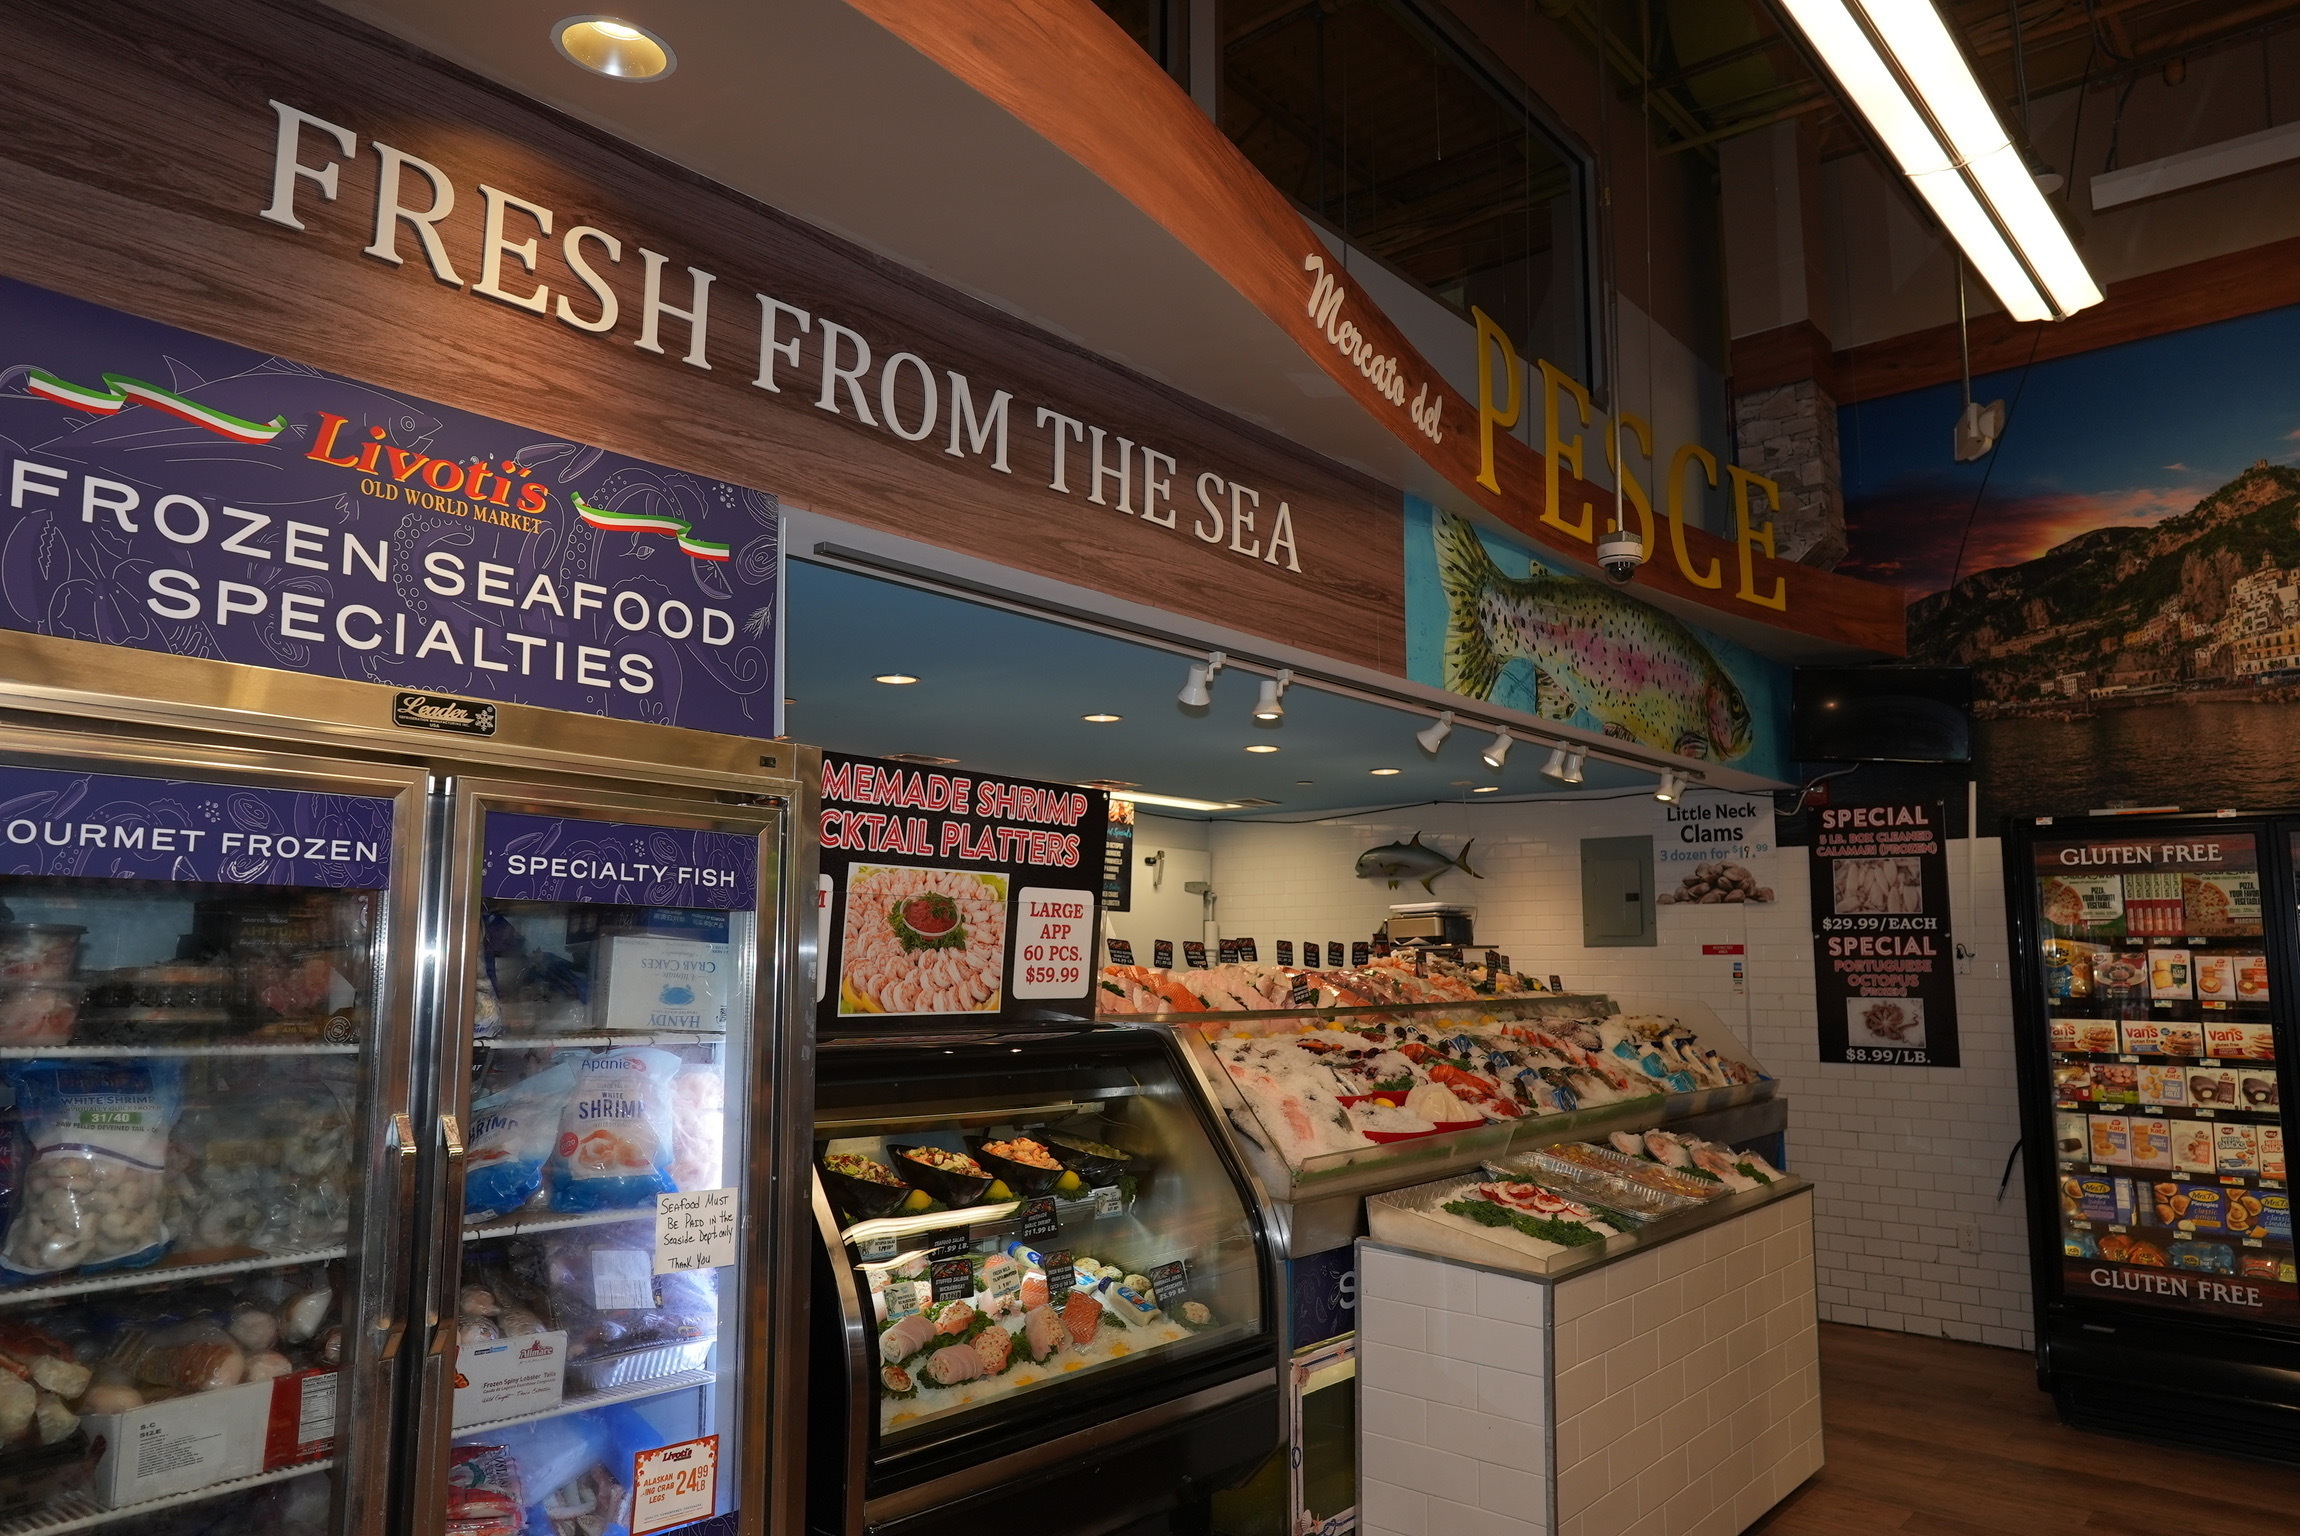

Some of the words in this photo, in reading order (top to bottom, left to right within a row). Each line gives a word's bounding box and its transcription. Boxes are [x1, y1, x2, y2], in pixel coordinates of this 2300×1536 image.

[259, 98, 717, 371] FRESH
[751, 292, 1014, 474] FROM
[1036, 406, 1177, 530] THE
[1194, 471, 1302, 574] SEA
[1304, 252, 1406, 407] Mercato
[1411, 382, 1443, 445] del
[304, 410, 550, 515] Livoti's
[1471, 304, 1787, 612] PESCE
[360, 478, 401, 503] OLD
[404, 485, 470, 518] WORLD
[472, 498, 542, 535] MARKET
[11, 458, 390, 584] FROZEN
[423, 549, 736, 648] SEAFOOD
[146, 568, 655, 695] SPECIALTIES
[397, 696, 475, 723] Leader
[976, 780, 1088, 828] SHRIMP
[1667, 804, 1711, 822] Little
[1715, 801, 1757, 819] Neck
[1822, 805, 1929, 829] SPECIAL
[1680, 823, 1744, 844] Clams
[1848, 833, 1874, 844] BOX
[1876, 830, 1933, 843] CLEANED
[221, 832, 378, 863] FROZEN
[940, 820, 1081, 868] PLATTERS
[1660, 850, 1668, 862] 3
[1670, 849, 1707, 861] dozen
[1709, 848, 1729, 859] for
[2060, 846, 2152, 866] GLUTEN
[2161, 844, 2223, 863] FREE
[507, 854, 675, 884] SPECIALTY
[677, 867, 735, 888] FISH
[1029, 900, 1084, 919] LARGE
[1040, 923, 1071, 940] APP
[1822, 917, 1938, 931] $29.99/EACH
[1023, 945, 1043, 961] 60
[1048, 946, 1083, 962] PCS.
[1828, 936, 1937, 957] SPECIAL
[641, 957, 680, 972] CAKES
[682, 960, 716, 974] CRAB
[1834, 959, 1932, 973] PORTUGUESE
[1025, 966, 1080, 985] $59.99
[1847, 973, 1920, 987] OCTOPUS
[646, 1013, 702, 1029] HANDY
[1846, 1048, 1932, 1064] $8.99/LB.
[61, 1096, 104, 1105] WHITE
[106, 1095, 156, 1104] SHRIMP
[91, 1113, 130, 1123] 31/40
[578, 1100, 647, 1120] SHRIMP
[2191, 1200, 2219, 1209] Pierogies
[667, 1216, 679, 1229] BE
[685, 1213, 704, 1228] PAID
[719, 1210, 734, 1223] the
[2090, 1267, 2188, 1298] GLUTEN
[2198, 1280, 2264, 1308] FREE
[483, 1380, 503, 1388] Frozen
[504, 1378, 519, 1386] Spiny
[520, 1373, 541, 1382] Lobster
[139, 1428, 162, 1439] SIZE
[641, 1486, 655, 1497] ING
[657, 1481, 674, 1493] CRAB
[643, 1473, 673, 1487] ALASKAN
[675, 1467, 698, 1495] 24
[697, 1464, 709, 1479] 99
[696, 1479, 706, 1492] LB
[649, 1493, 666, 1504] LEGS
